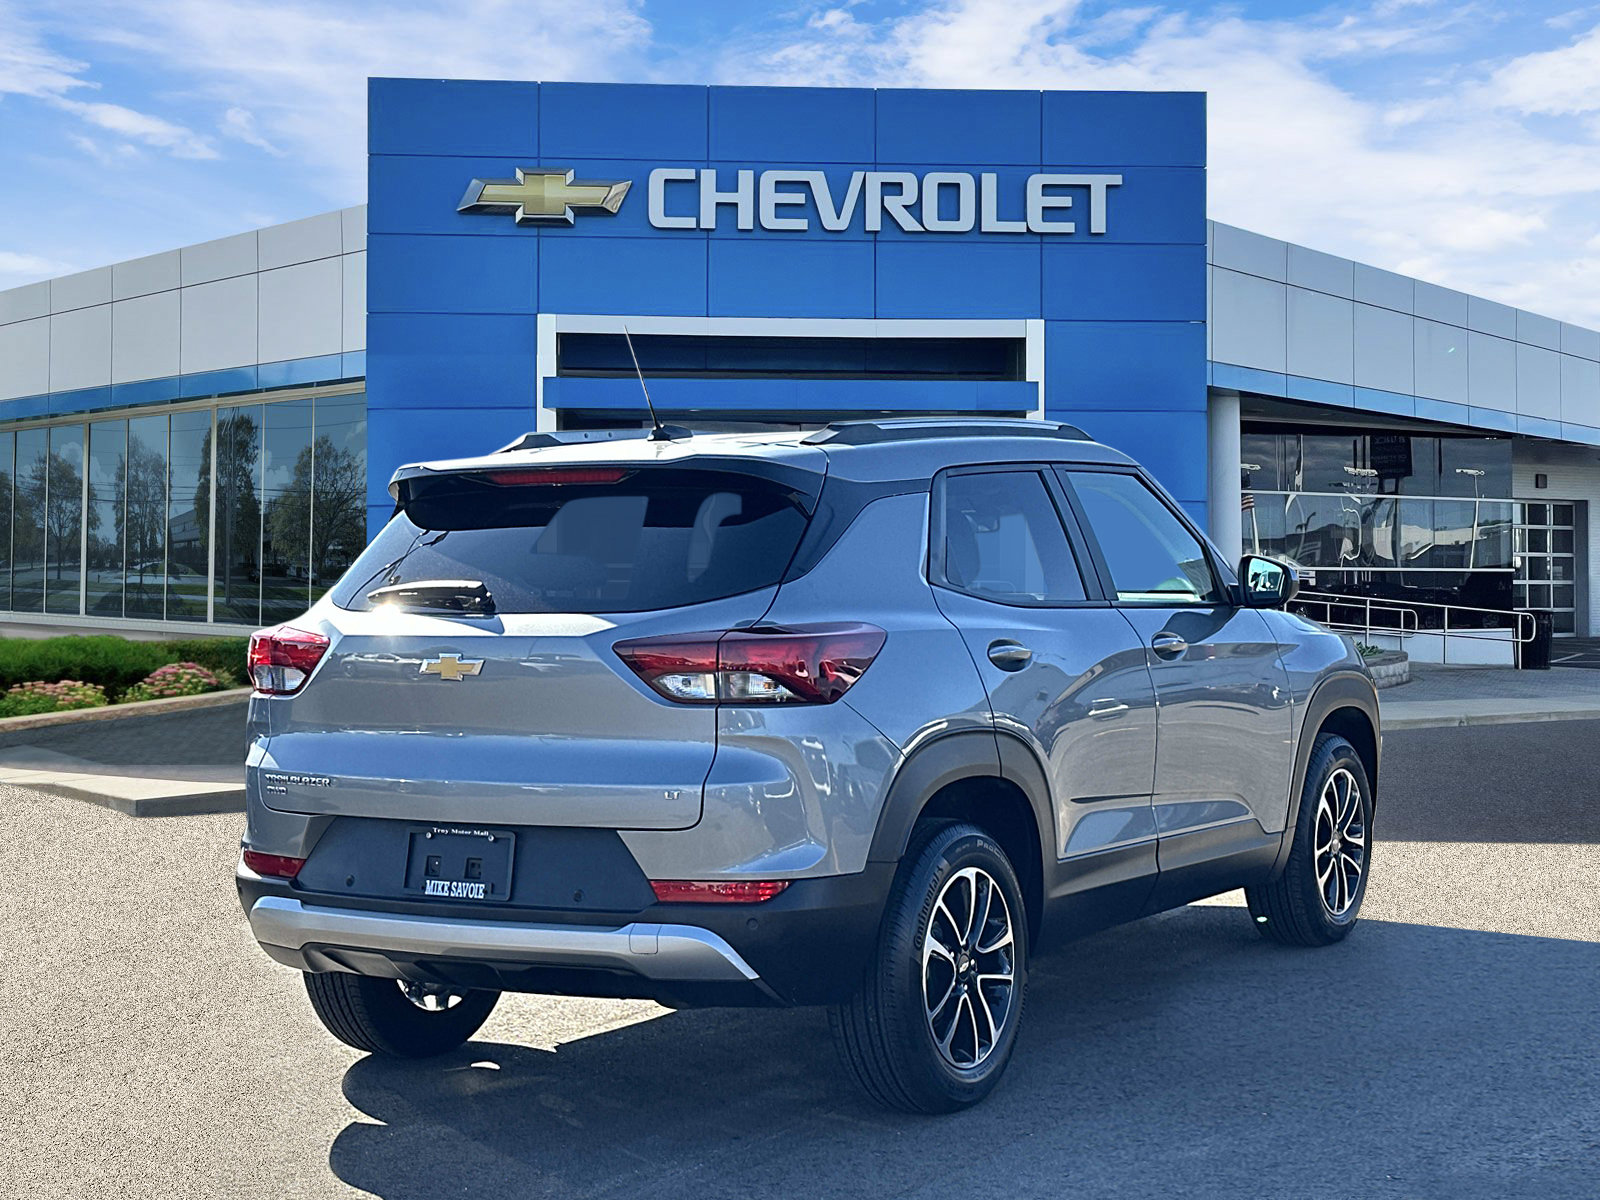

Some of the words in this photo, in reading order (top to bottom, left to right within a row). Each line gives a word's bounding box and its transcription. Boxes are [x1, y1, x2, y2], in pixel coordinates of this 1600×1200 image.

[647, 167, 1123, 234] CHEVROLET
[264, 773, 331, 788] TRAILBLAZER
[664, 790, 681, 801] LT
[432, 826, 449, 835] Troy
[424, 879, 450, 897] MIKE
[450, 881, 485, 899] SAVOIE
